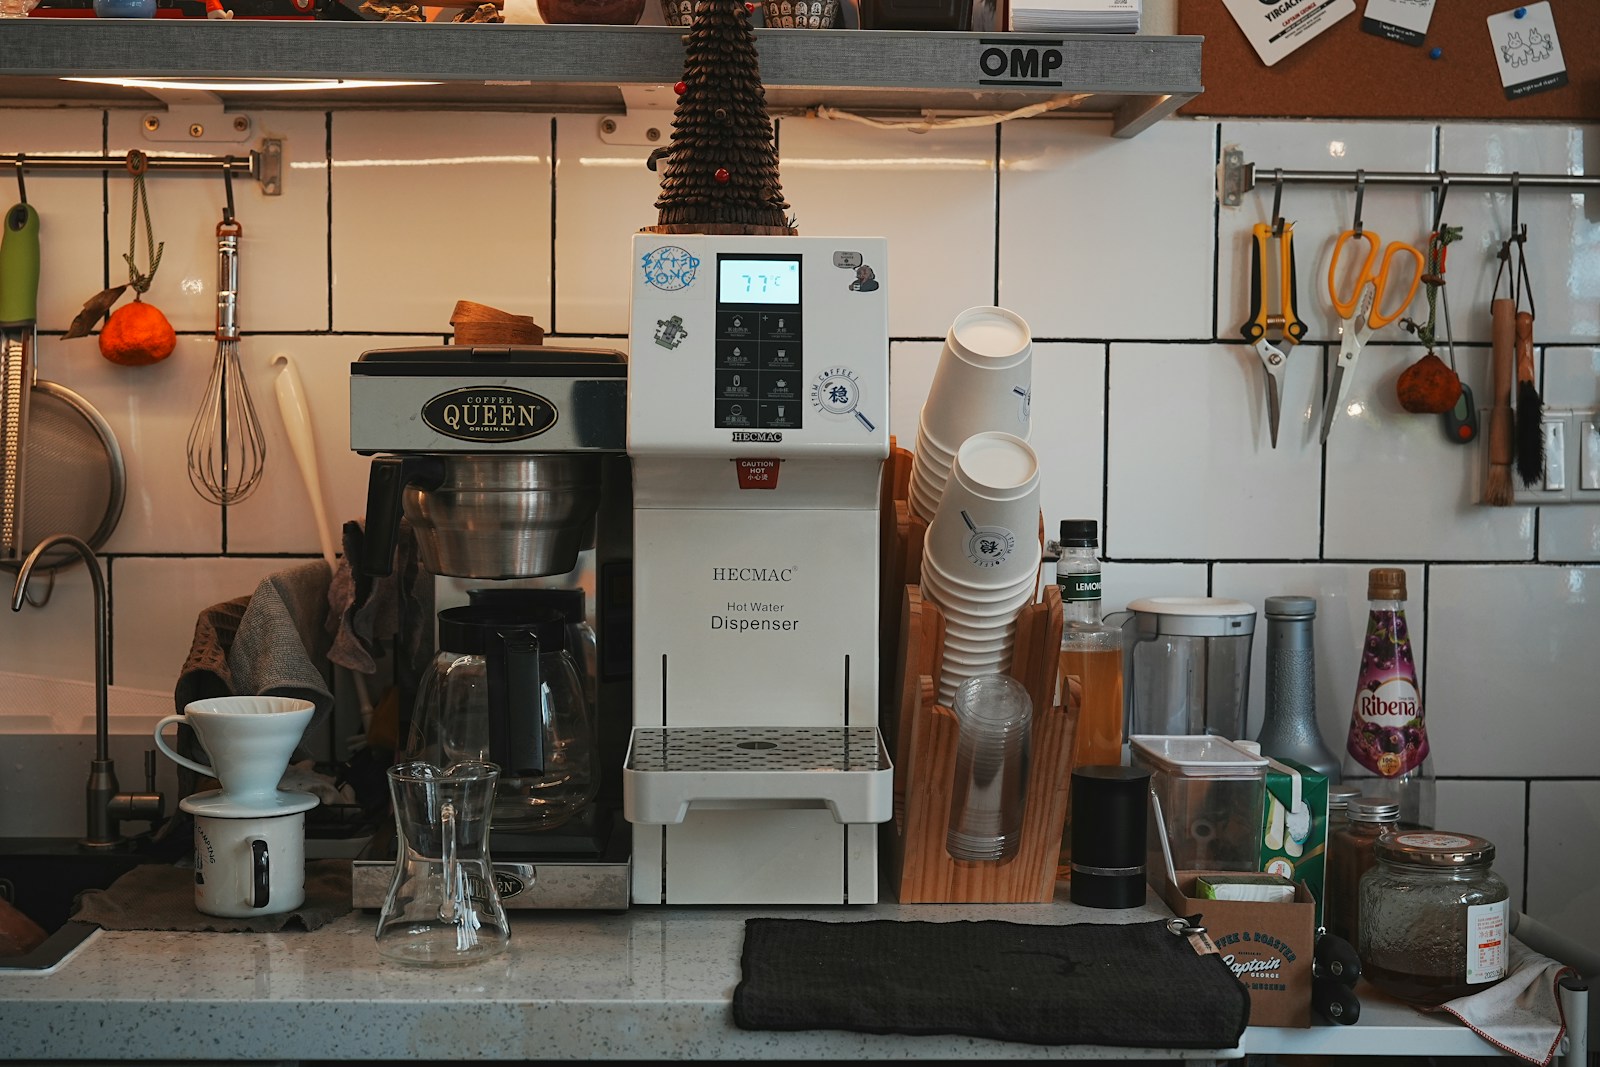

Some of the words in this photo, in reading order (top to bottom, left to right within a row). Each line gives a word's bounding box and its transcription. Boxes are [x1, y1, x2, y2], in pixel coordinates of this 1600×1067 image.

[980, 47, 1063, 78] OMP
[467, 396, 513, 404] COFFEE
[828, 385, 849, 404] 稳
[443, 404, 536, 431] QUEEN
[733, 432, 782, 442] HECMAC
[727, 602, 747, 612] Hot
[750, 602, 785, 612] Water
[711, 615, 799, 633] Dispenser
[1362, 694, 1415, 716] Ribena
[1215, 932, 1240, 951] FFEE
[1242, 931, 1251, 942] &
[1254, 932, 1297, 964] ROASTER
[1222, 954, 1281, 978] Captain
